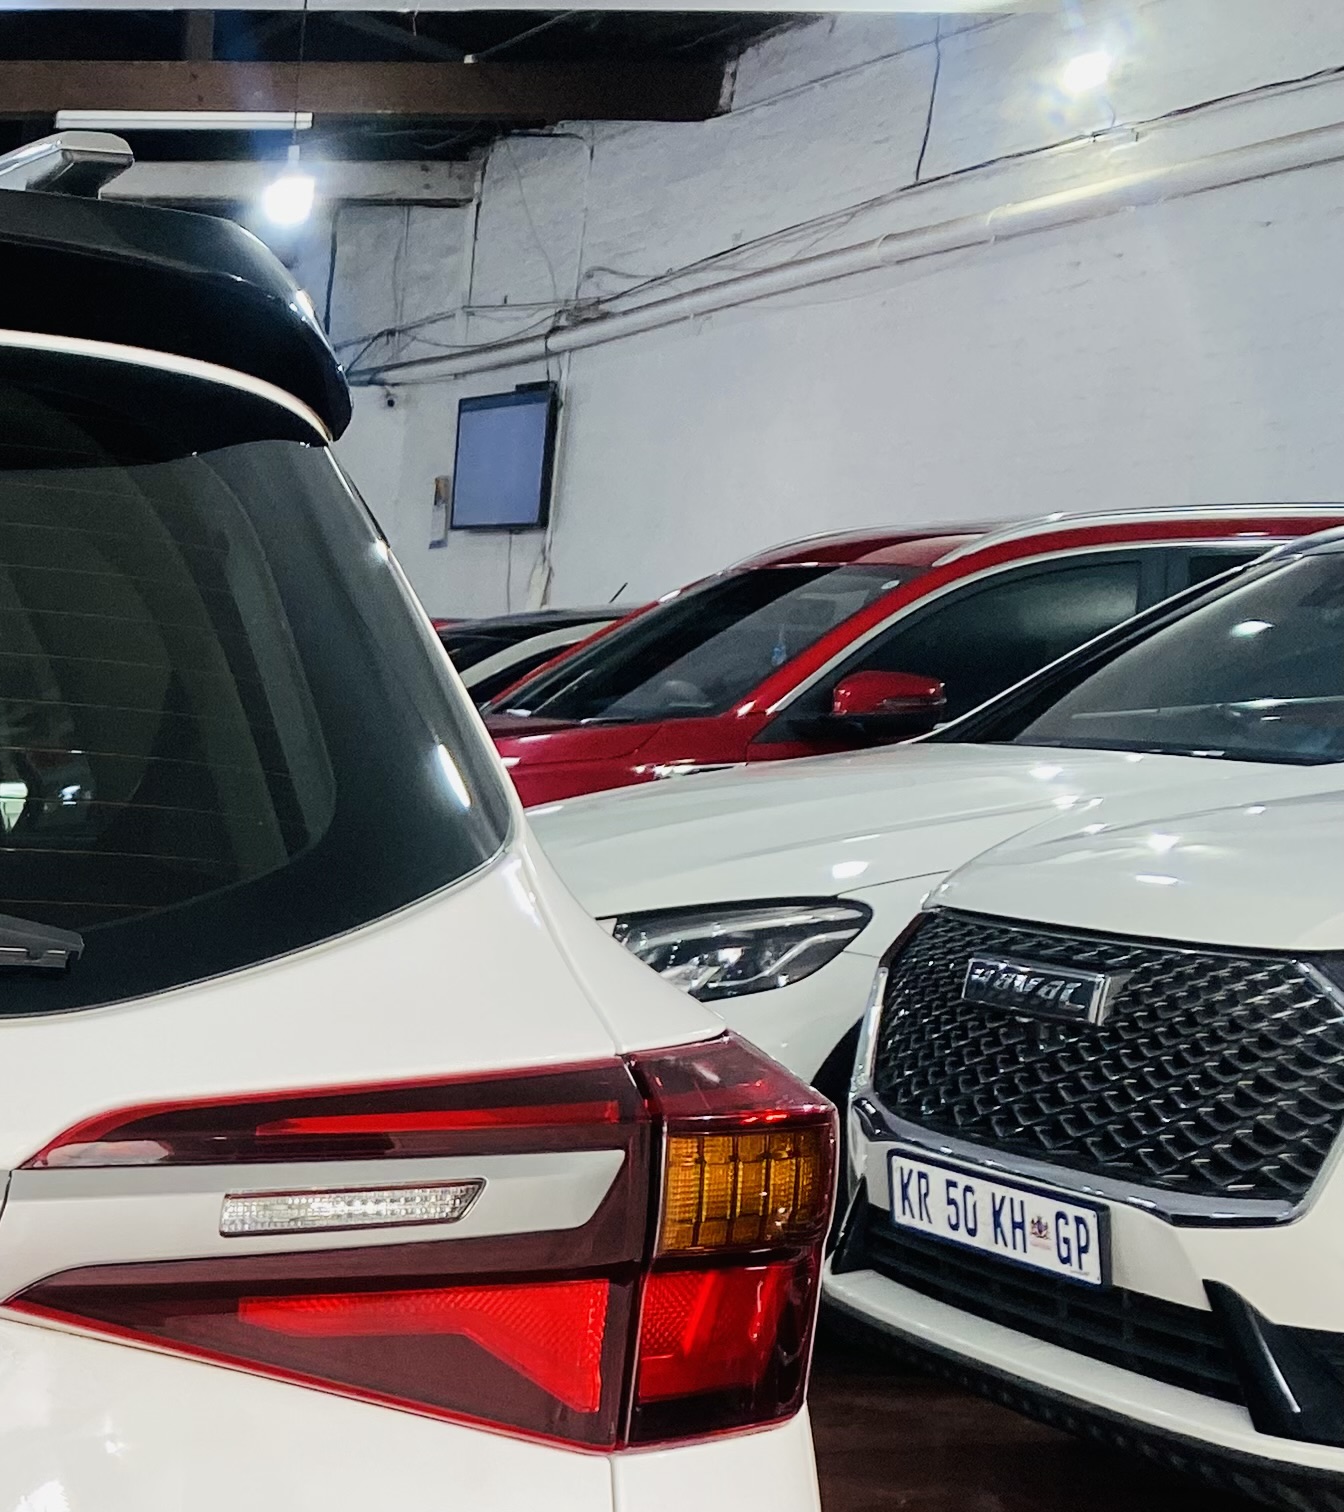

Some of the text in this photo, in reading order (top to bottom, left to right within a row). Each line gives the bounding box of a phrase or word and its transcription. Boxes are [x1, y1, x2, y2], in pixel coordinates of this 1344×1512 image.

[899, 1165, 1091, 1271] KR 50 KH GP
